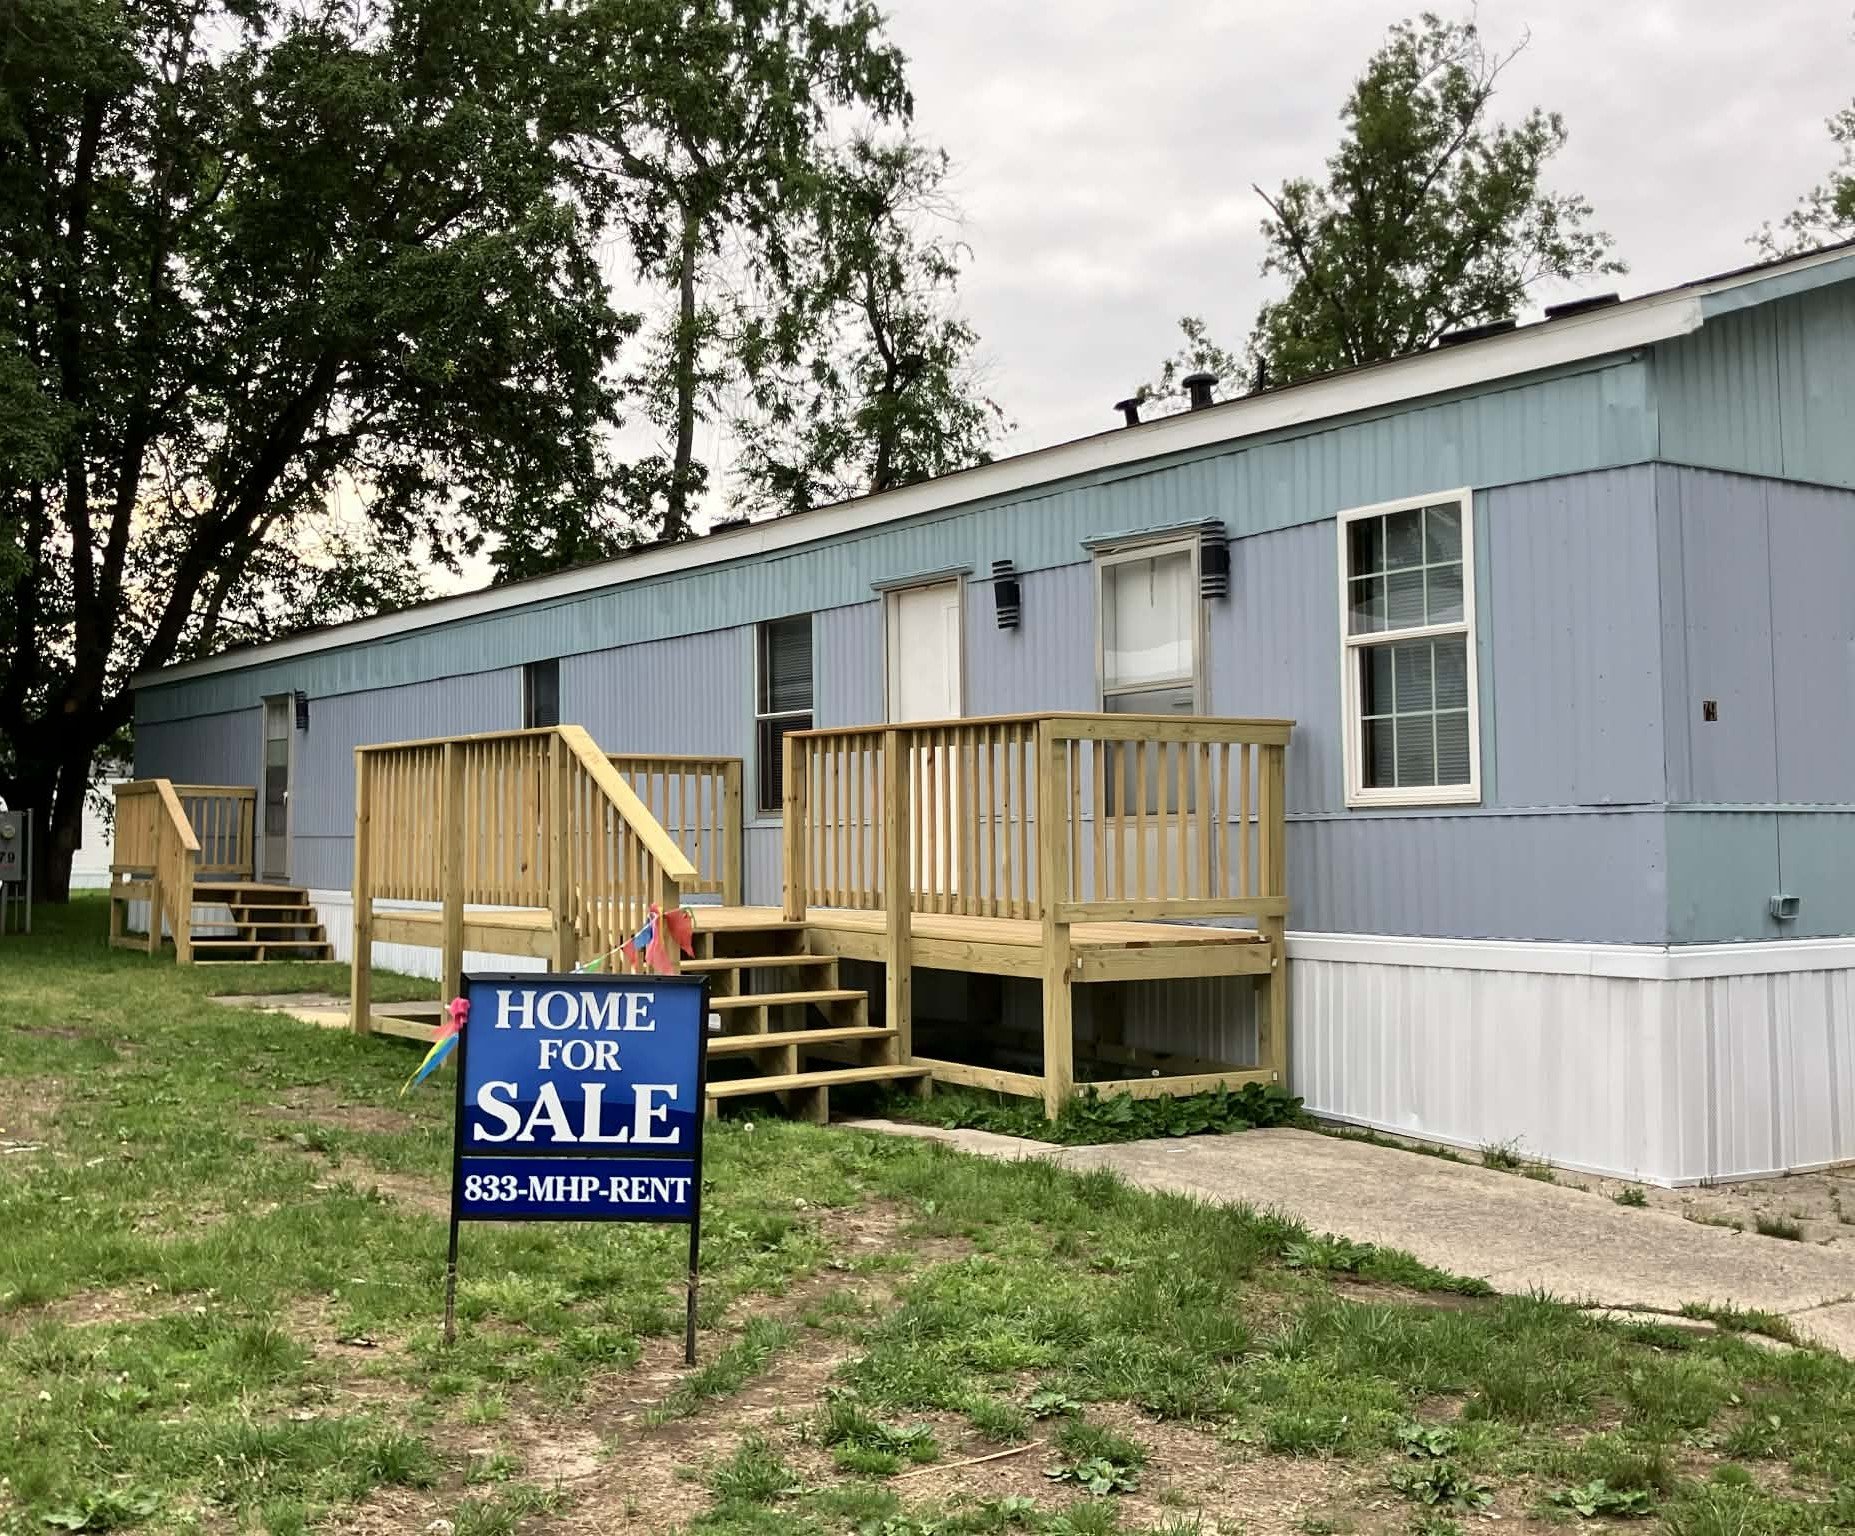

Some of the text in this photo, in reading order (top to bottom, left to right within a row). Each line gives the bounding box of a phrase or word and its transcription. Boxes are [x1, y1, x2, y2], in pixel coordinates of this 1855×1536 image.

[494, 990, 656, 1031] HOME
[538, 1039, 622, 1071] FOR
[473, 1080, 680, 1144] SALE
[464, 1174, 691, 1203] 833-MHP-RENT
